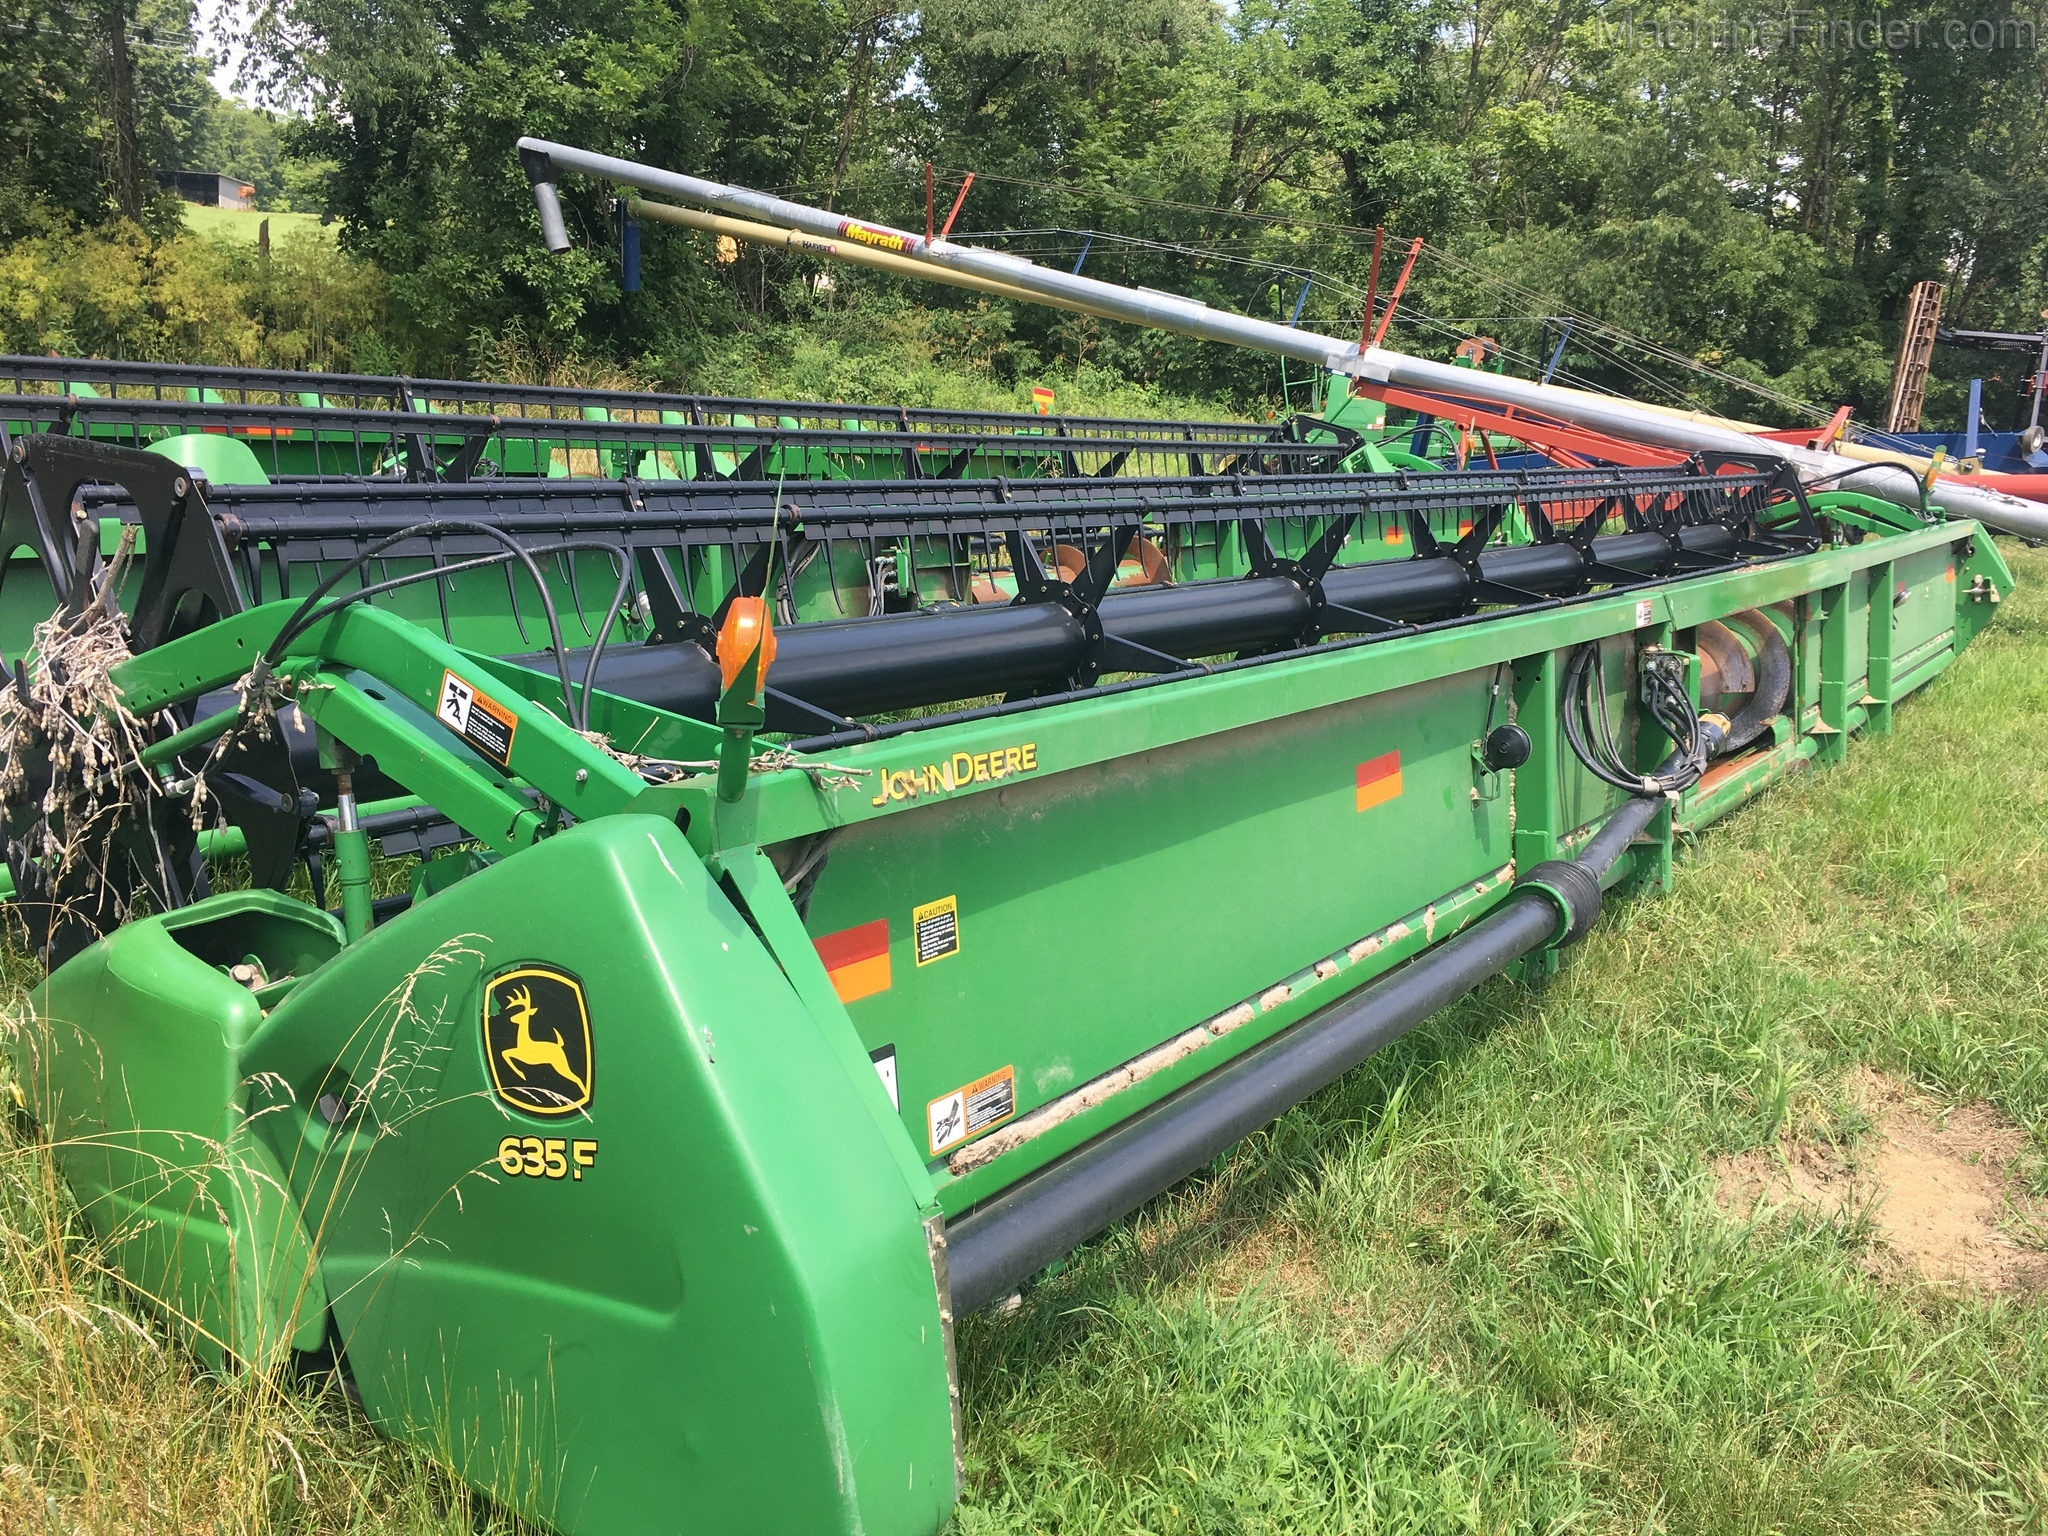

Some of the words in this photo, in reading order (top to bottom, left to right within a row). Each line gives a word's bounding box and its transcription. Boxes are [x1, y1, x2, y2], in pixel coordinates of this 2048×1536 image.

[845, 222, 905, 251] Mayrath
[481, 697, 513, 724] WARNING
[872, 761, 955, 808] JOHN
[952, 742, 1038, 786] DEERE
[923, 902, 953, 919] CAUTION
[978, 1070, 1006, 1091] WARNING
